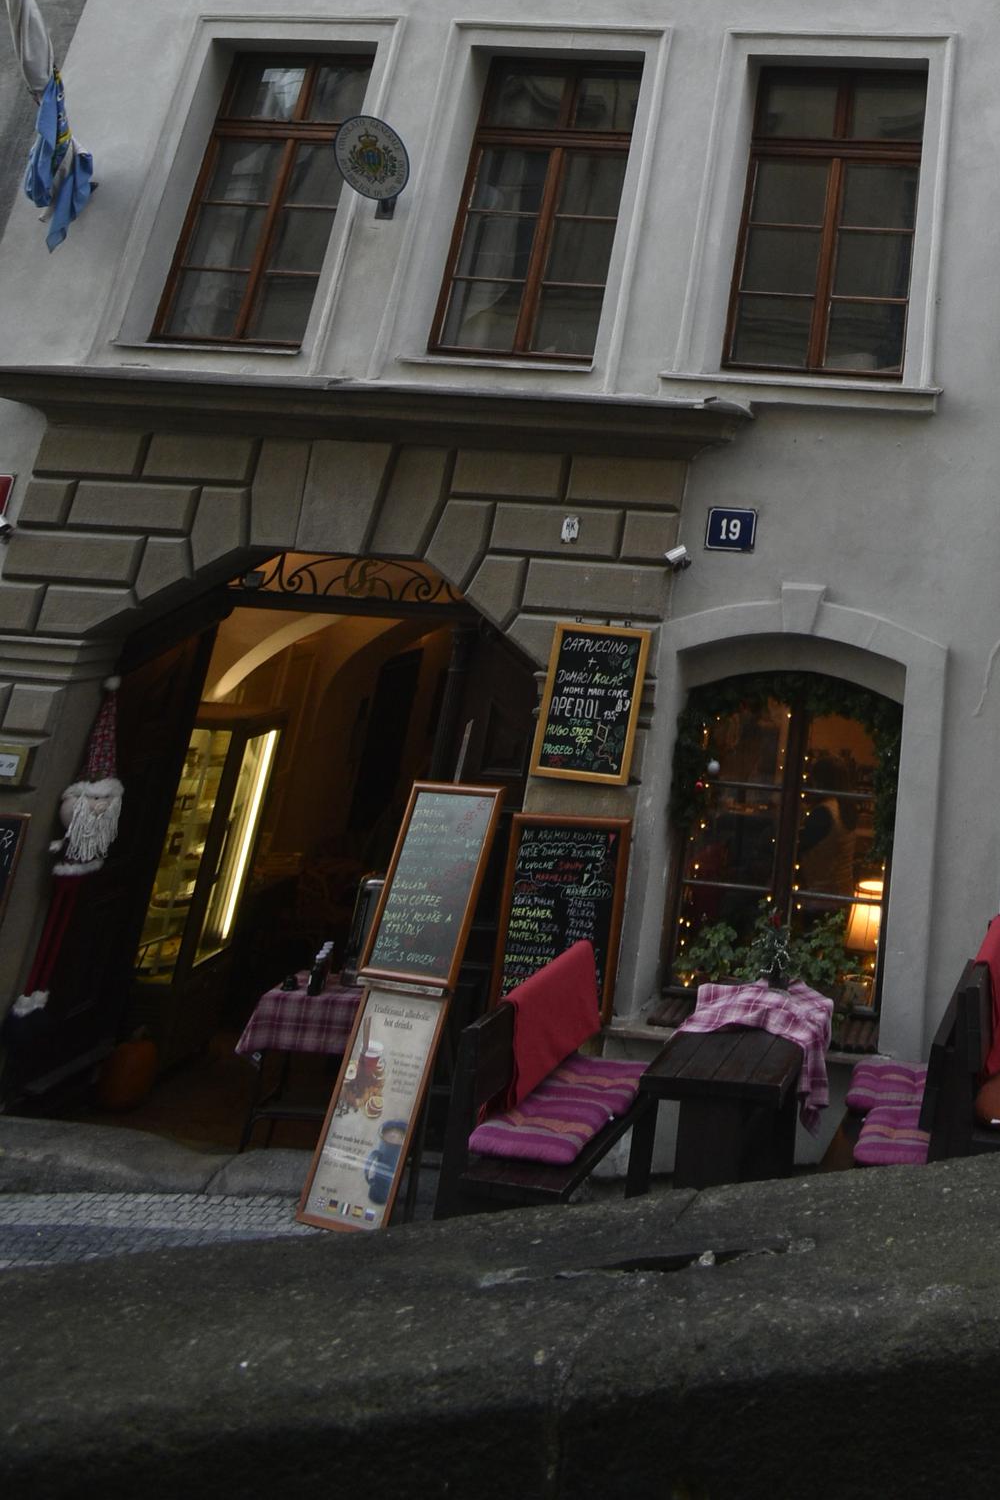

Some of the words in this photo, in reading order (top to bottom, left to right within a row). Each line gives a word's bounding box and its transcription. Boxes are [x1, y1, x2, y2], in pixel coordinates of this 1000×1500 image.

[720, 518, 741, 540] 19
[562, 637, 628, 655] CAPPUCCINO
[563, 686, 584, 695] HOME
[587, 688, 605, 696] MADE
[607, 689, 629, 698] CAKE
[550, 696, 602, 720] APEROL
[545, 723, 569, 736] HUGO
[409, 894, 442, 907] COFFEE
[384, 1018, 394, 1027] hot
[394, 1020, 413, 1030] drinks
